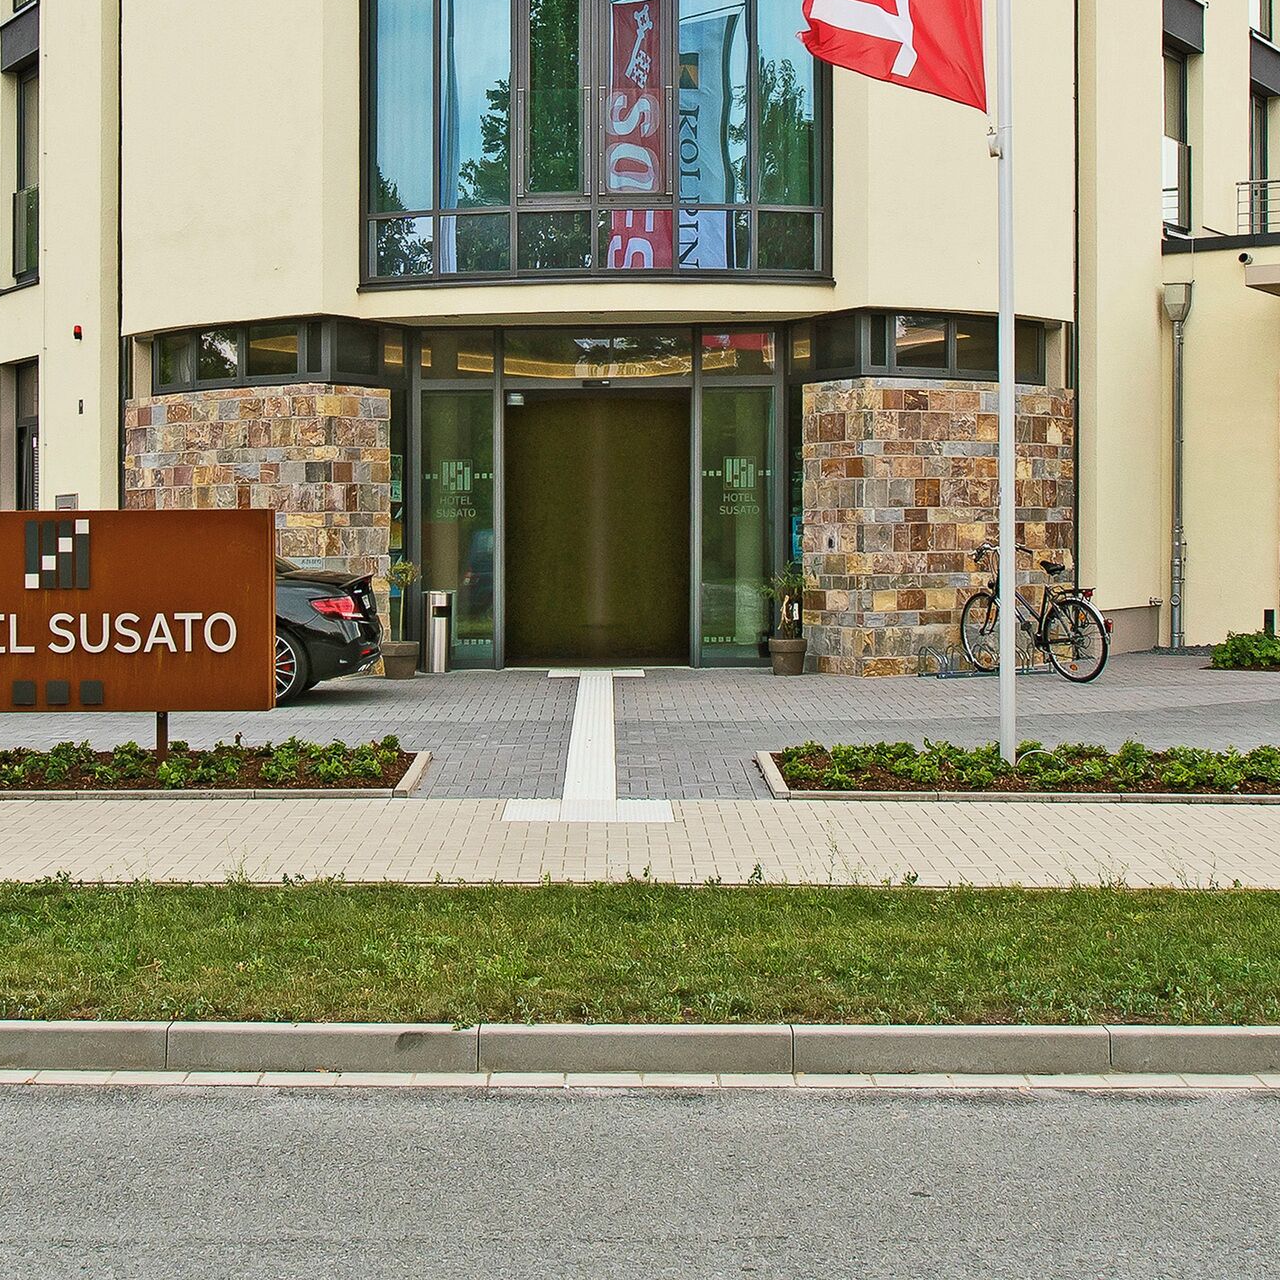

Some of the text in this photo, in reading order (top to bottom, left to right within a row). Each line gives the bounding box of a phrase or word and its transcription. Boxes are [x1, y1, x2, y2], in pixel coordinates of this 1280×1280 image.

[439, 495, 473, 506] HOTEL
[723, 492, 757, 503] HOTEL
[436, 508, 477, 518] SUSATO
[719, 505, 760, 516] SUSATO
[47, 611, 238, 655] SUSATO
